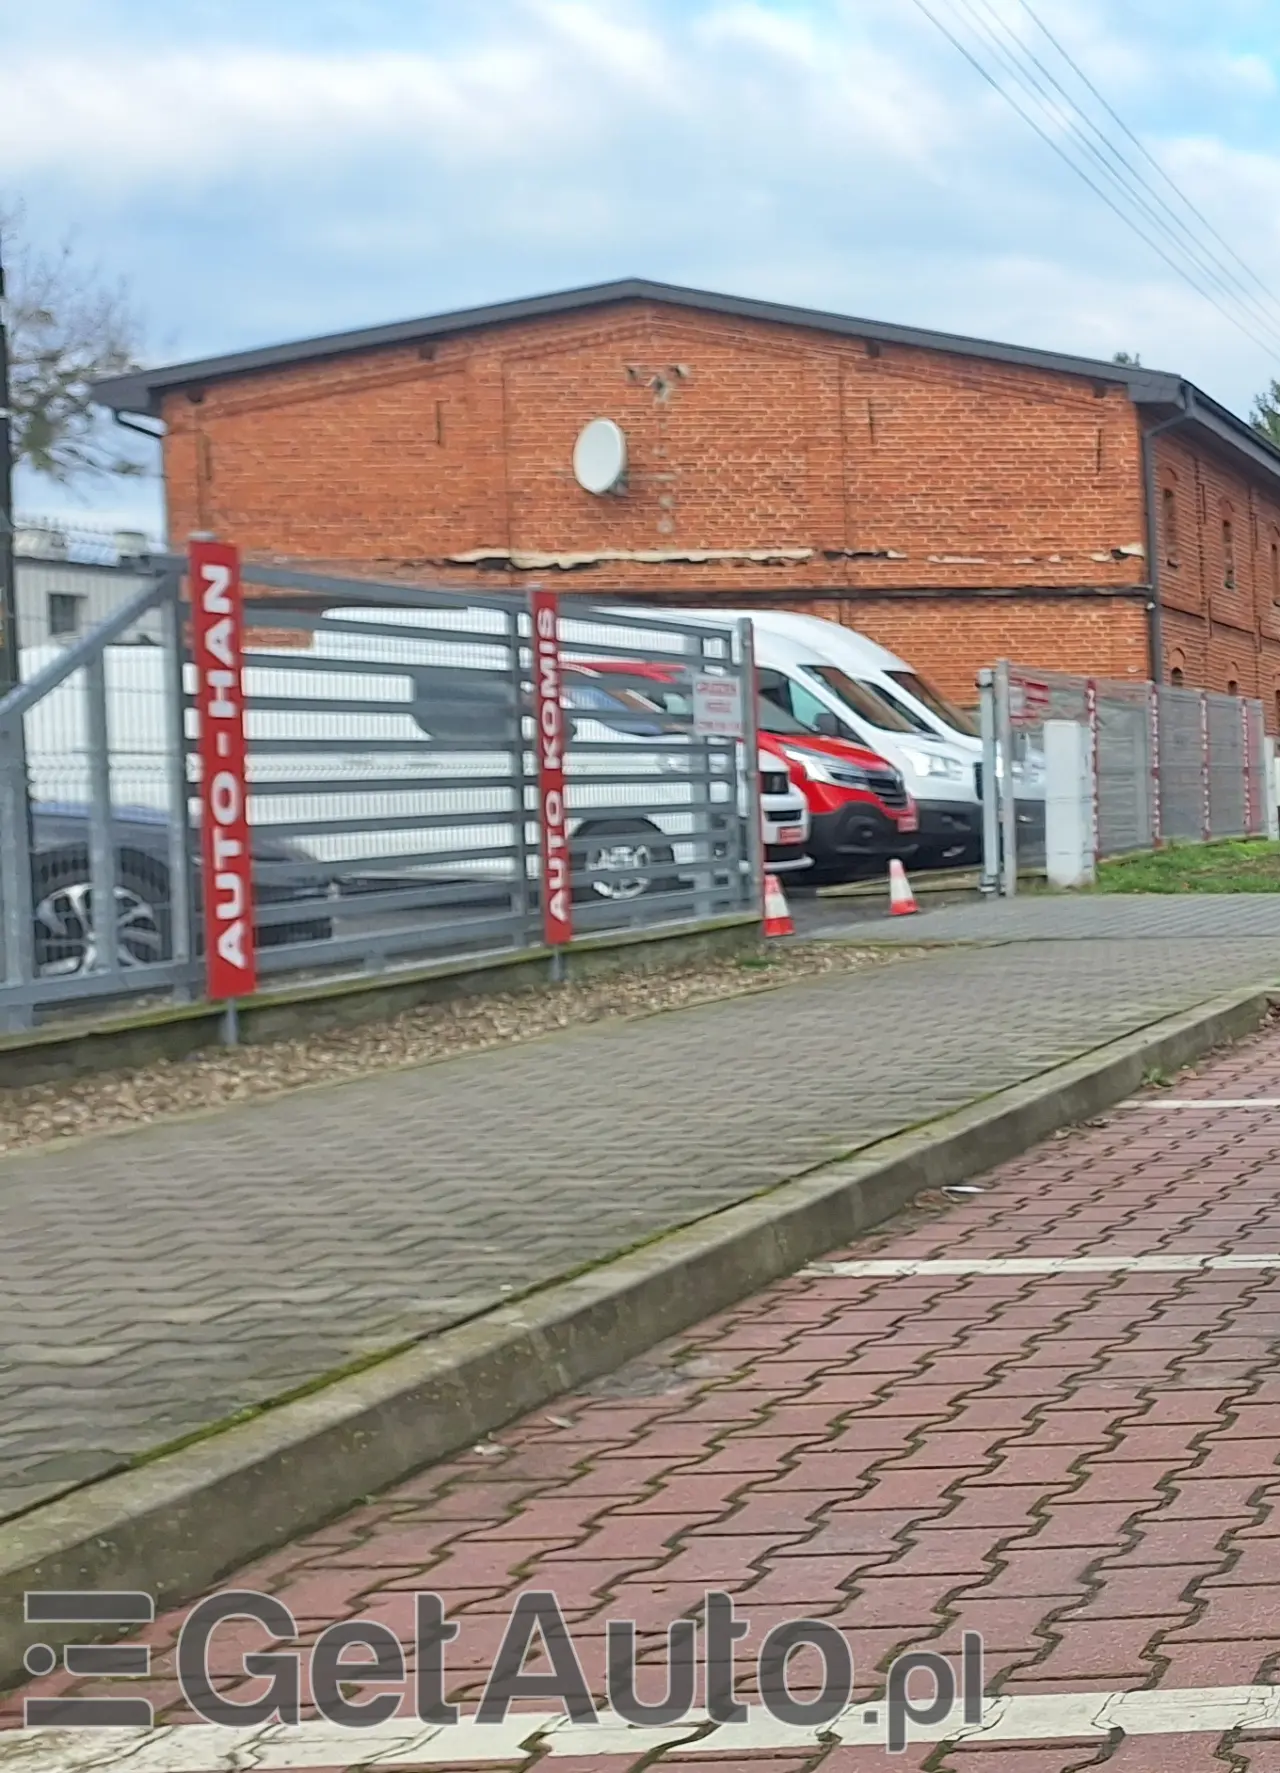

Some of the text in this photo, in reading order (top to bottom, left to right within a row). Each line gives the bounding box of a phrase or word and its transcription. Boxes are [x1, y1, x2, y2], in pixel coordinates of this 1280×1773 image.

[201, 564, 237, 719] HAN
[537, 607, 568, 923] AUTO KOMIS
[211, 771, 247, 969] AUTO
